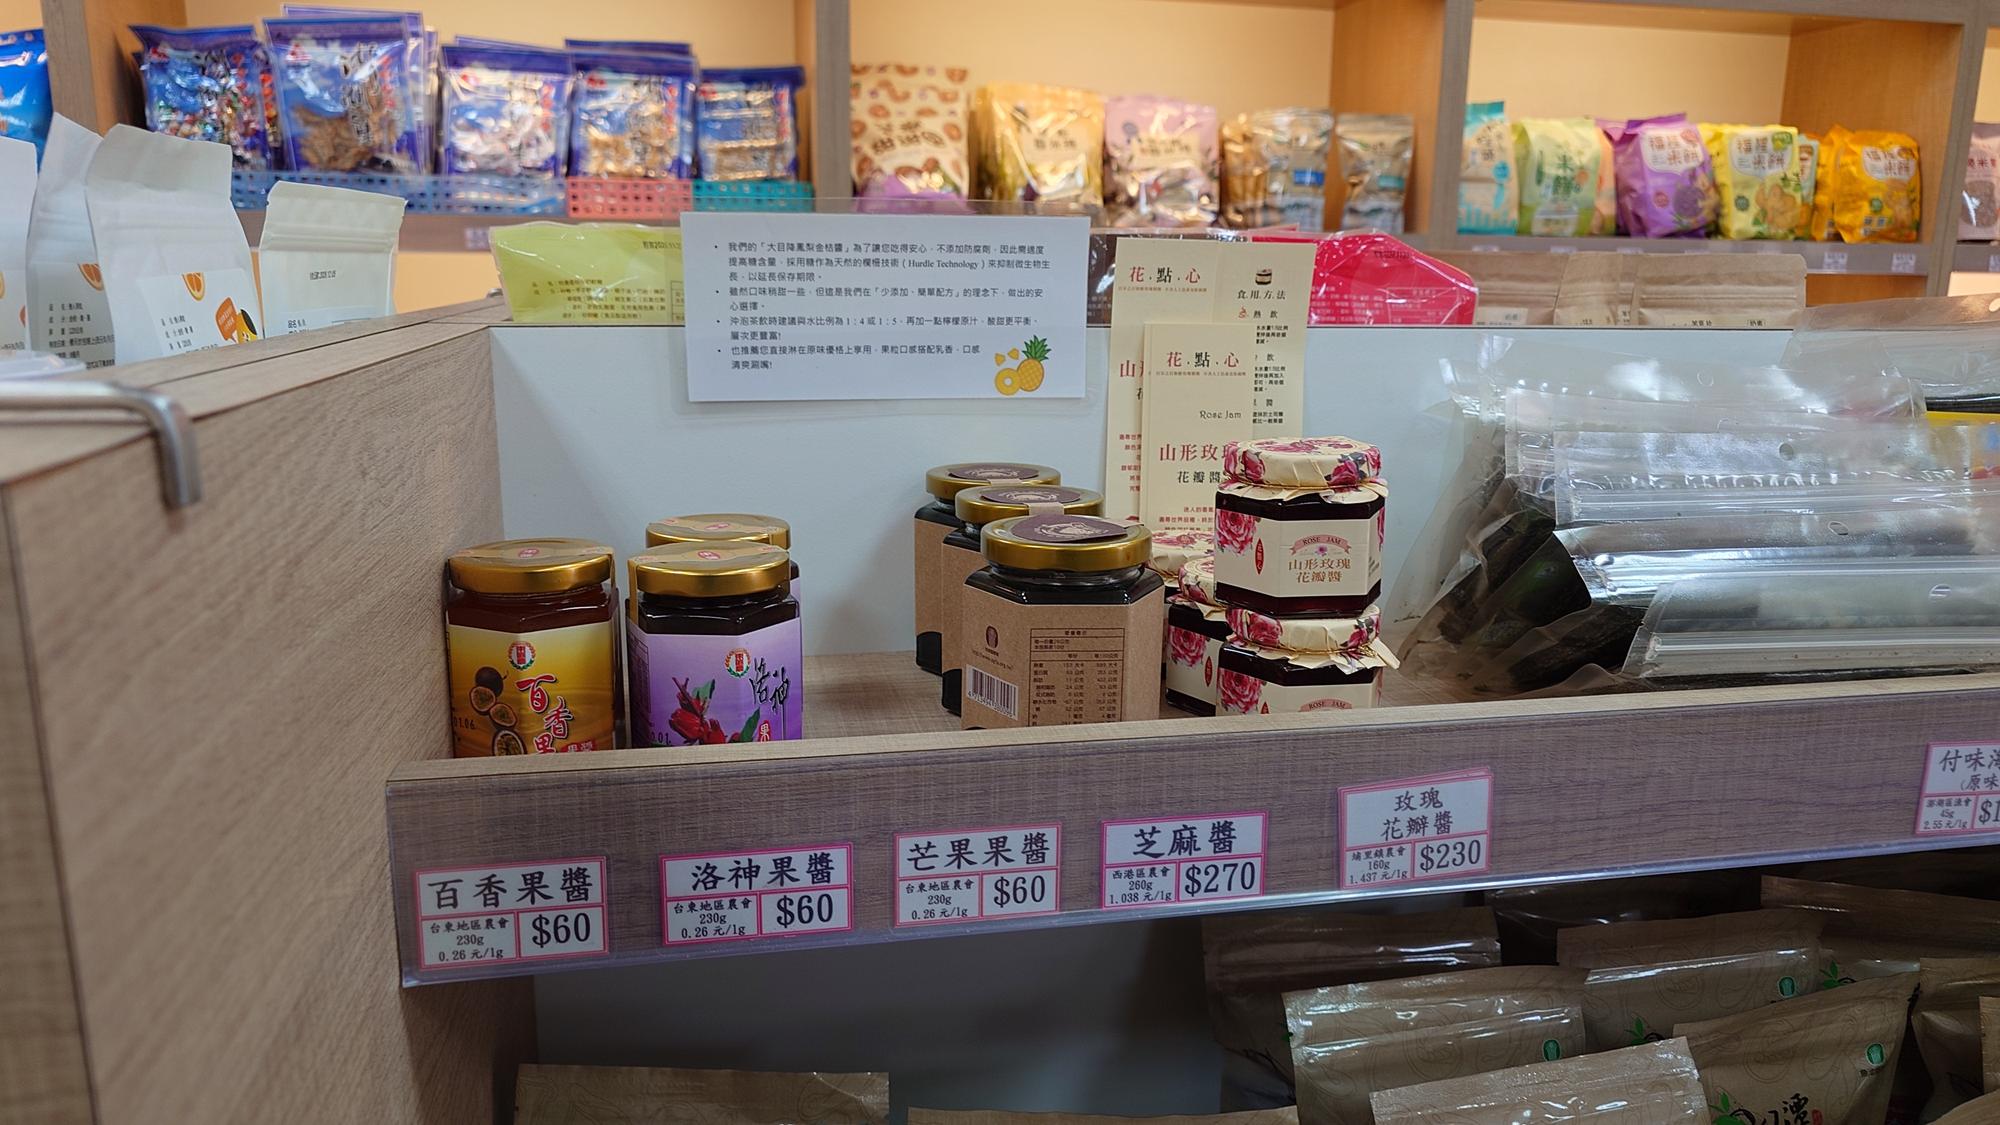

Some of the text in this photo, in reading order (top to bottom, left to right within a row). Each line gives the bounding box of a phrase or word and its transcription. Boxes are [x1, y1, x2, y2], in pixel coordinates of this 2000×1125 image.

[1120, 360, 1143, 377] 山
[1199, 410, 1223, 419] Rose
[1225, 410, 1242, 419] Jam
[1159, 444, 1225, 461] 山形玫
[1288, 558, 1351, 571] 山形玫瑰
[1296, 571, 1343, 583] 花瓣醬
[1394, 787, 1444, 812] 玫瑰
[1133, 820, 1237, 859] 芝麻醬
[906, 831, 1050, 873] 芒果果醬
[1419, 839, 1481, 873] $230
[692, 852, 836, 892] 洛神果醬
[1111, 866, 1171, 880] 西港區農會
[1367, 859, 1391, 870] 160g
[905, 877, 975, 894] 台東地區農會
[1128, 880, 1153, 891] 260g
[1184, 861, 1256, 897] $270
[1349, 872, 1377, 884] 1.437
[428, 867, 593, 910] 百香果醬
[993, 874, 1046, 910] $60
[673, 895, 752, 915] 台東地區農會
[927, 895, 952, 906] 230g
[1109, 892, 1139, 905] 1.038
[699, 913, 727, 926] 230g
[775, 893, 834, 930] $60
[911, 908, 936, 920] 0.26
[429, 917, 510, 934] 台東地區農會
[531, 912, 592, 948] $60
[681, 926, 709, 940] 0.26
[456, 933, 485, 946] 230g
[438, 948, 467, 961] 0.26
